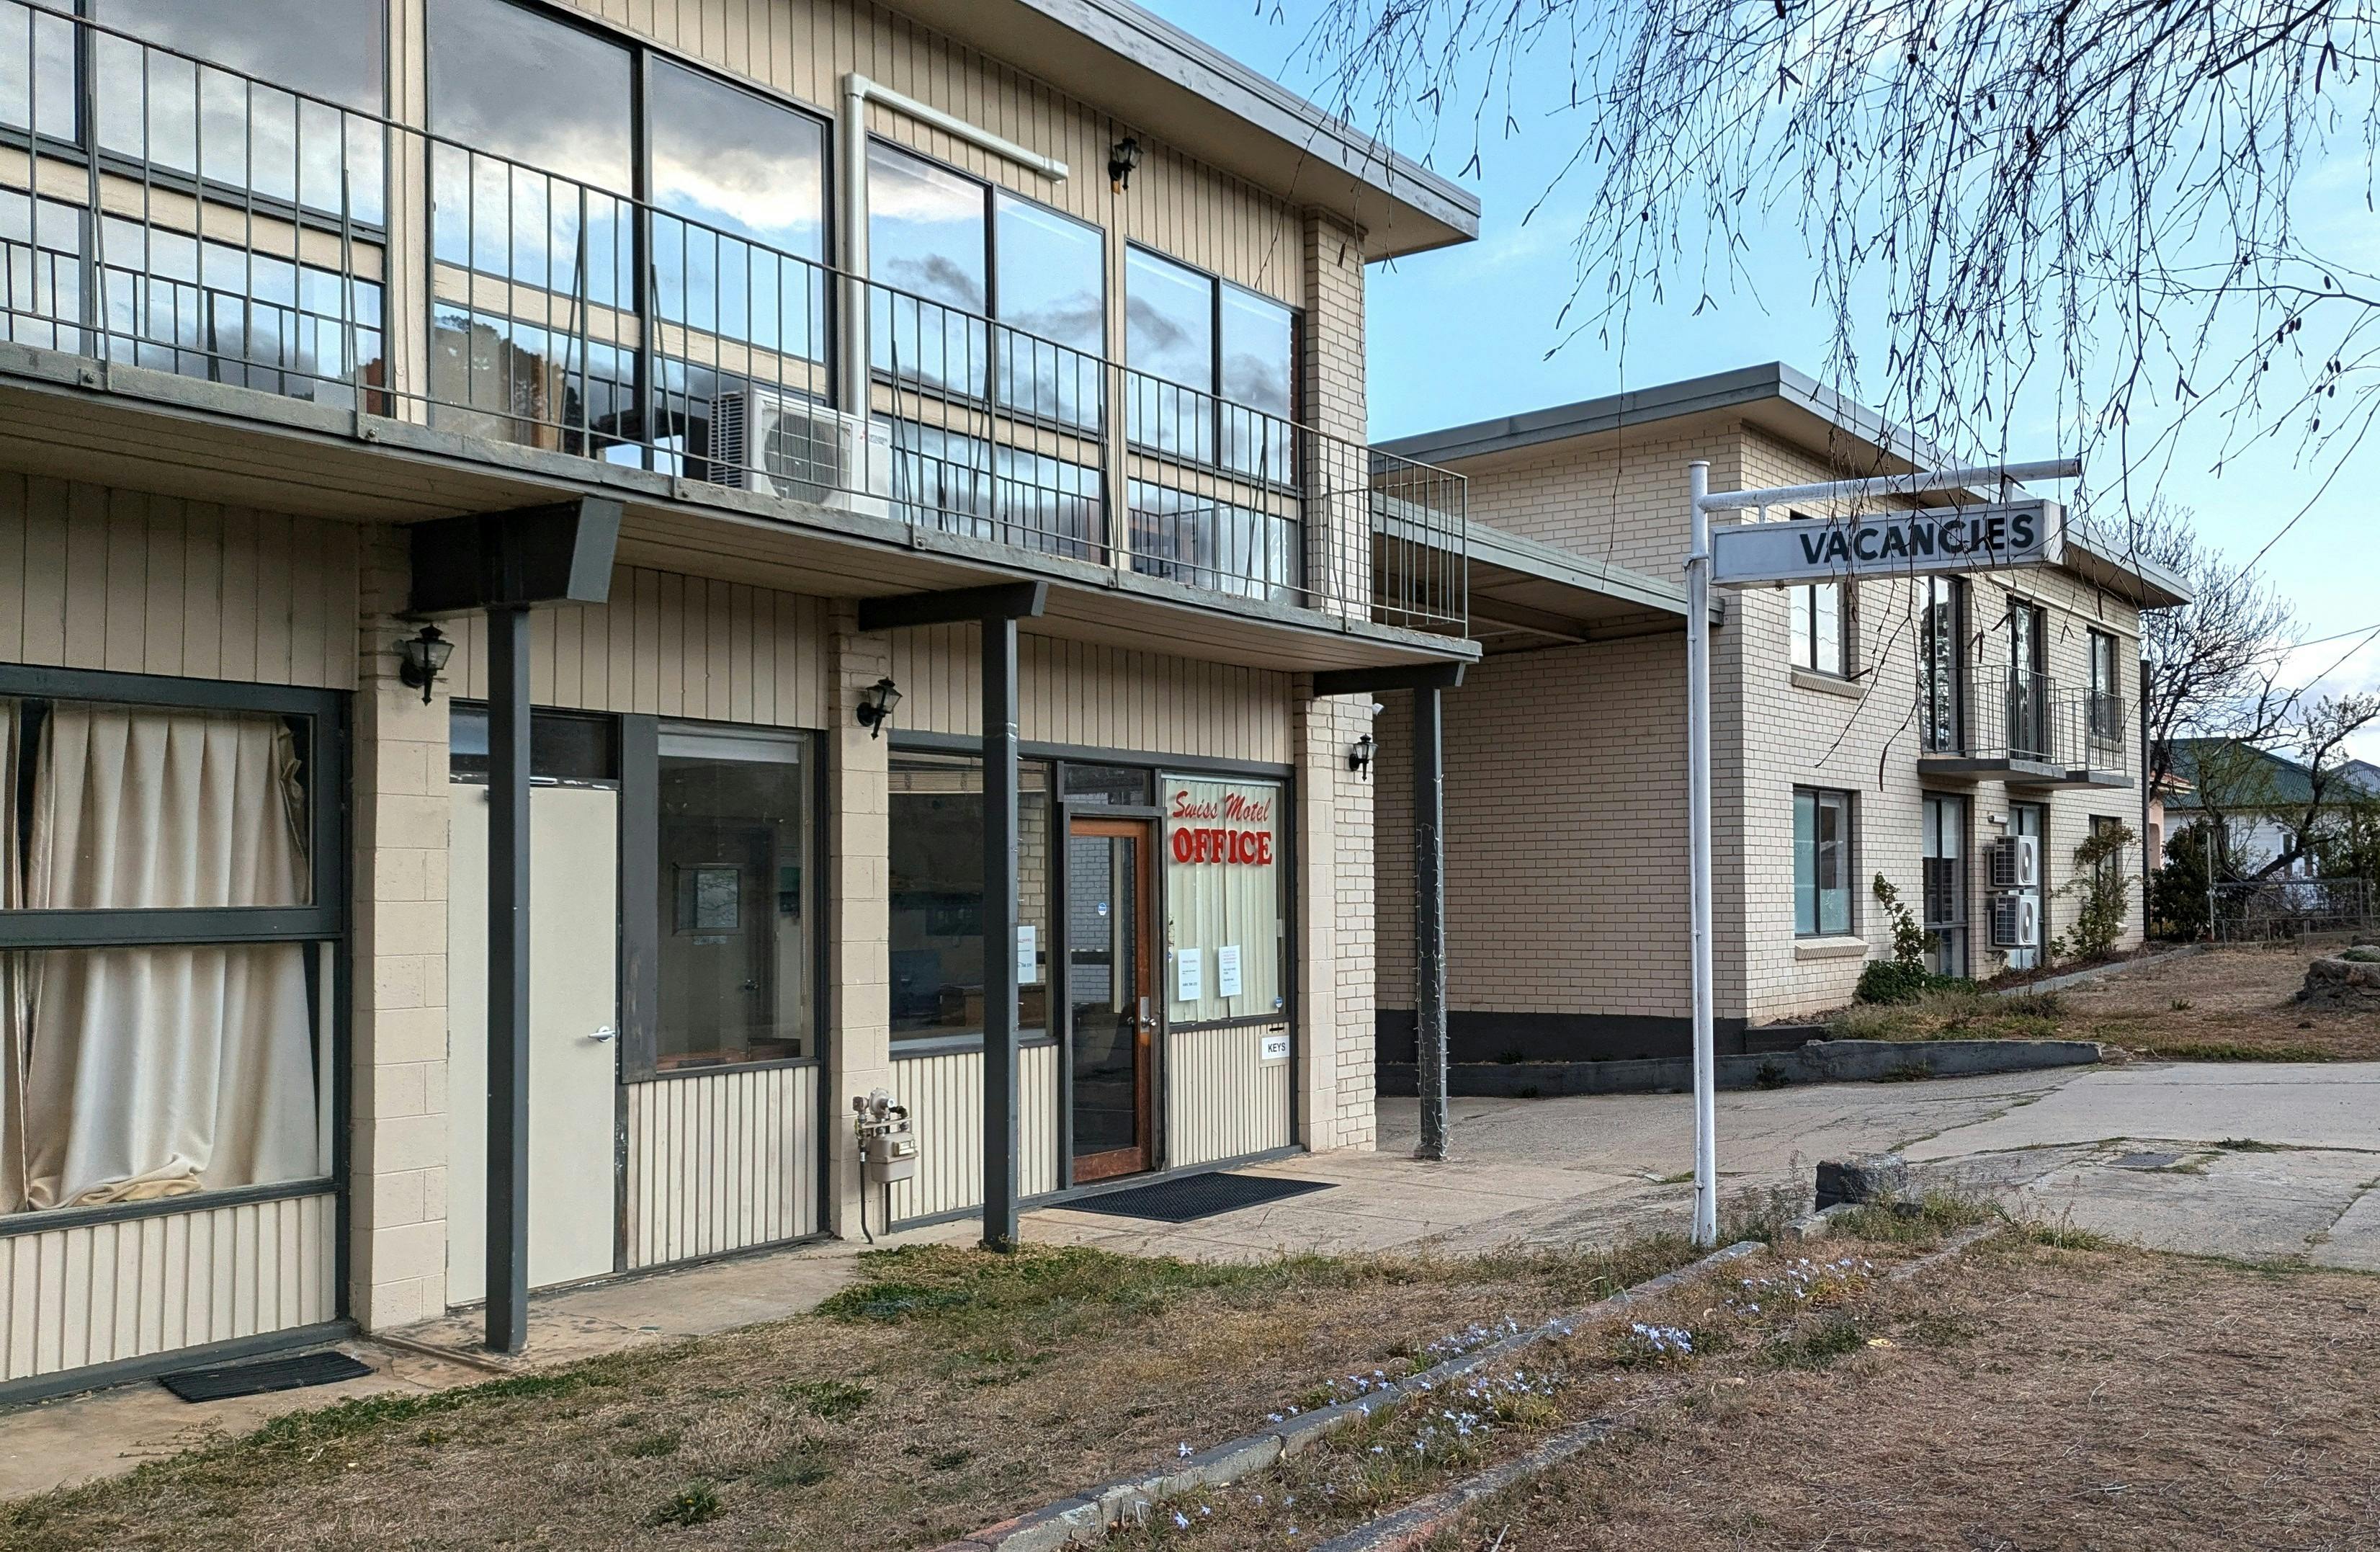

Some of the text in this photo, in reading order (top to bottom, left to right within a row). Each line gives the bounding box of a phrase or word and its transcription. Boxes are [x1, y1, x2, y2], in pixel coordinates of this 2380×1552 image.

[1799, 514, 2034, 564] VACANCIES
[1172, 790, 1271, 821] Swiss Motel
[1173, 827, 1273, 865] OFFICE
[1268, 1042, 1286, 1053] KEYS
